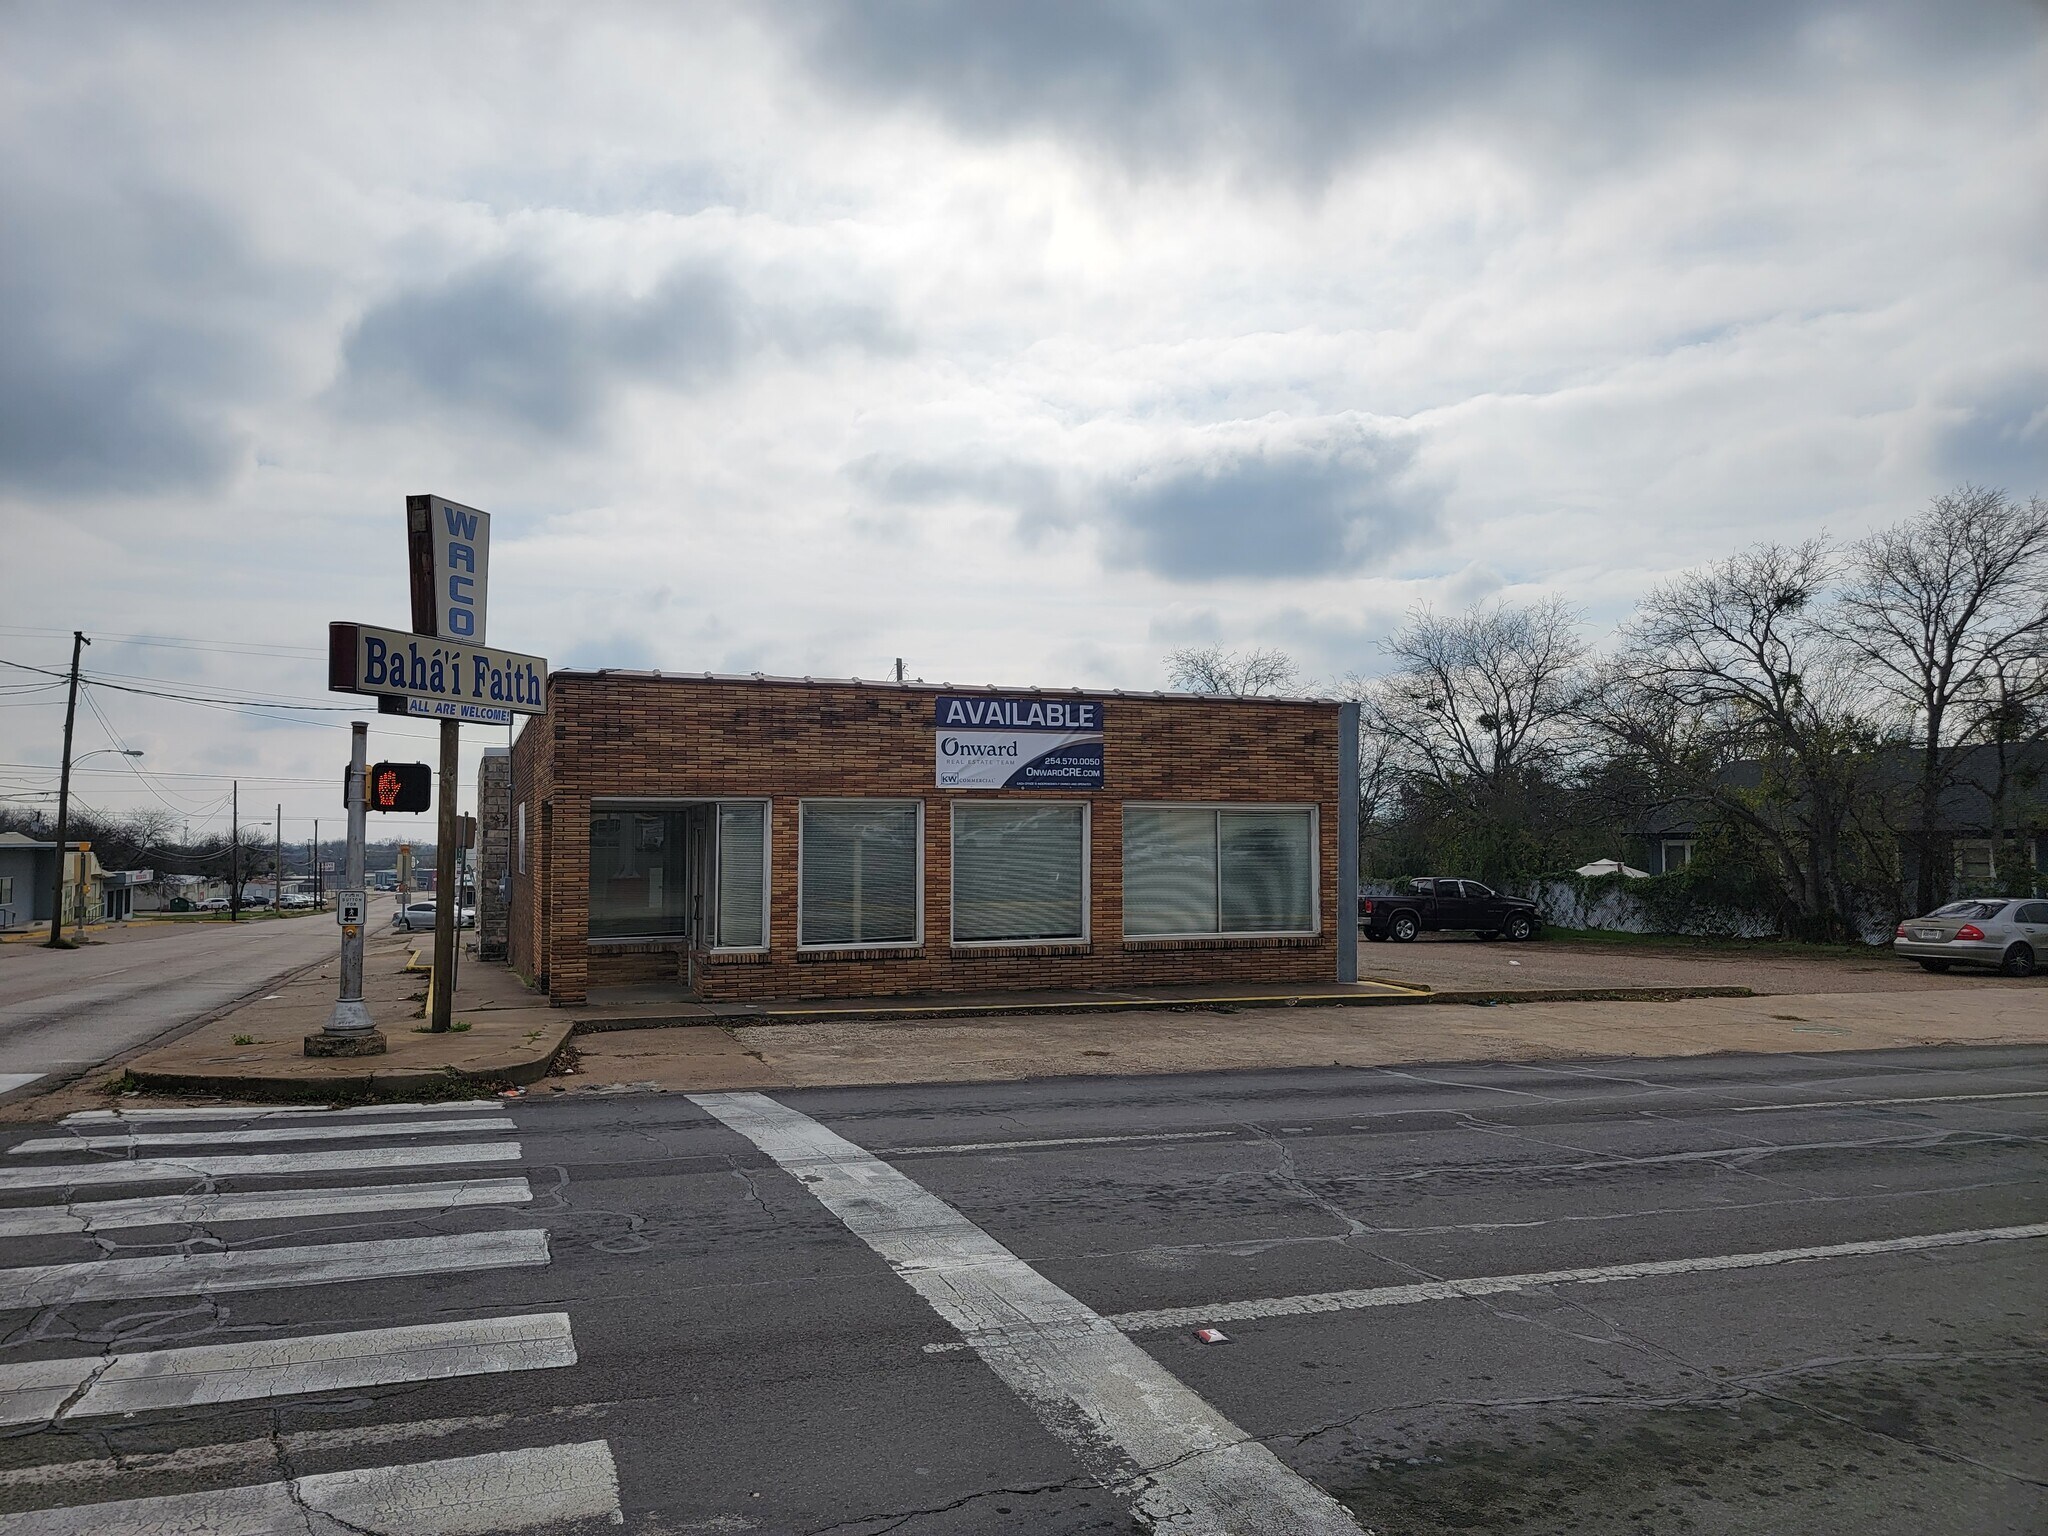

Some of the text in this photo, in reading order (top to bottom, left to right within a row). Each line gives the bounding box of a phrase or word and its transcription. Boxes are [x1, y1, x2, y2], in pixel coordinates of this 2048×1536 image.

[443, 506, 479, 637] WACO
[472, 655, 542, 706] Faith
[409, 698, 511, 722] ALL ARE WELCOME!
[946, 700, 1094, 728] AVAILABLE
[941, 736, 1018, 757] Onward
[1044, 757, 1100, 766] 254.570.0050
[942, 775, 957, 783] KW
